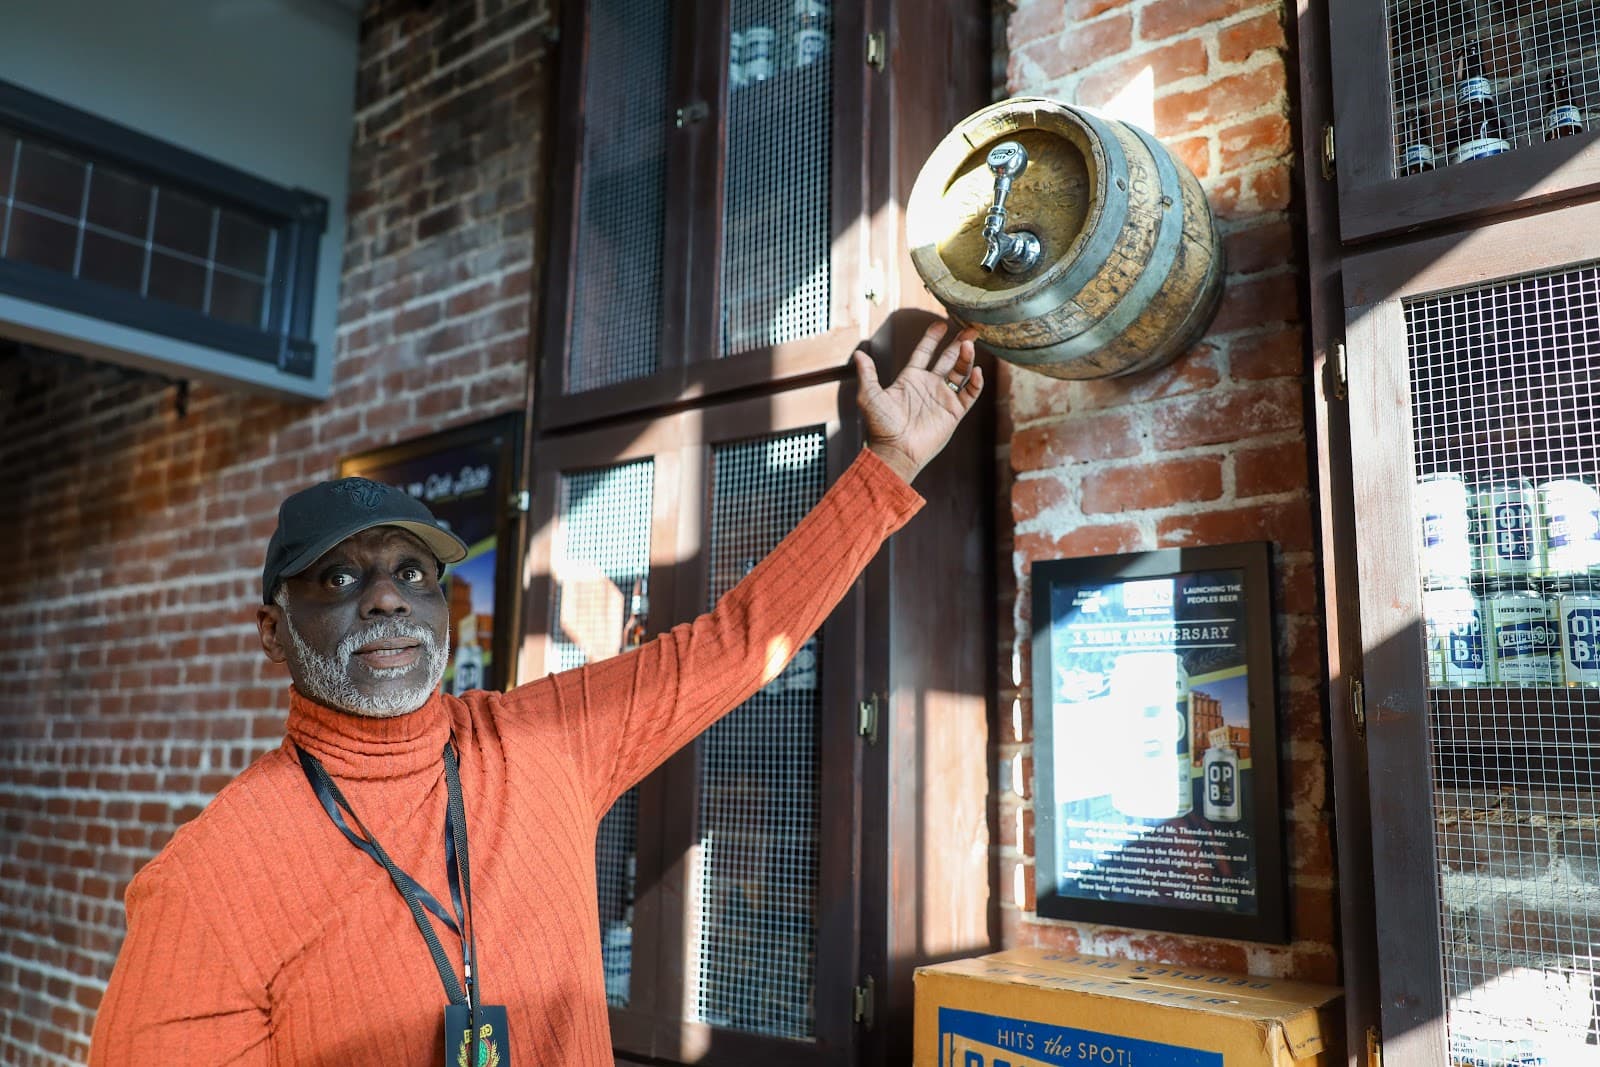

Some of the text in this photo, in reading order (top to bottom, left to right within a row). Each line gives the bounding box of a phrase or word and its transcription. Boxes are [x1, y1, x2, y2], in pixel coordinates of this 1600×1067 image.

[1500, 531, 1515, 553] B
[1183, 584, 1242, 595] LAUNCHING THE
[1187, 594, 1238, 604] PEOPLES BEER
[1126, 626, 1229, 642] ANNIVERSARY
[1455, 639, 1469, 661] B
[1574, 640, 1590, 661] B
[1210, 765, 1232, 782] OP
[1210, 784, 1221, 801] B
[1166, 825, 1178, 834] Mr.
[1179, 827, 1213, 836] Theodore
[1214, 829, 1234, 837] Mack
[1174, 836, 1202, 847] brewery
[1122, 854, 1147, 863] become
[1155, 857, 1170, 865] civil
[1171, 858, 1192, 868] rights
[1193, 861, 1215, 870] giant.
[1168, 848, 1187, 857] fields
[1189, 850, 1197, 858] of
[1199, 851, 1231, 860] Alabama
[1233, 854, 1247, 862] and
[1106, 866, 1140, 875] purchased
[1140, 867, 1167, 879] Peoples
[1168, 870, 1198, 882] Brewing
[1222, 876, 1249, 886] provide
[1078, 881, 1095, 889] brew
[1095, 882, 1110, 891] beer
[1111, 884, 1121, 892] for
[1122, 886, 1135, 894] the
[1174, 890, 1213, 902] PEOPLES
[1215, 895, 1238, 905] BEER
[1105, 876, 1150, 886] opportunities
[1160, 879, 1191, 891] minority
[1192, 884, 1239, 894] communities
[1241, 888, 1255, 896] and
[1042, 953, 1272, 991] PEOPLES BEER
[998, 1028, 1132, 1067] HITS the SPOT!
